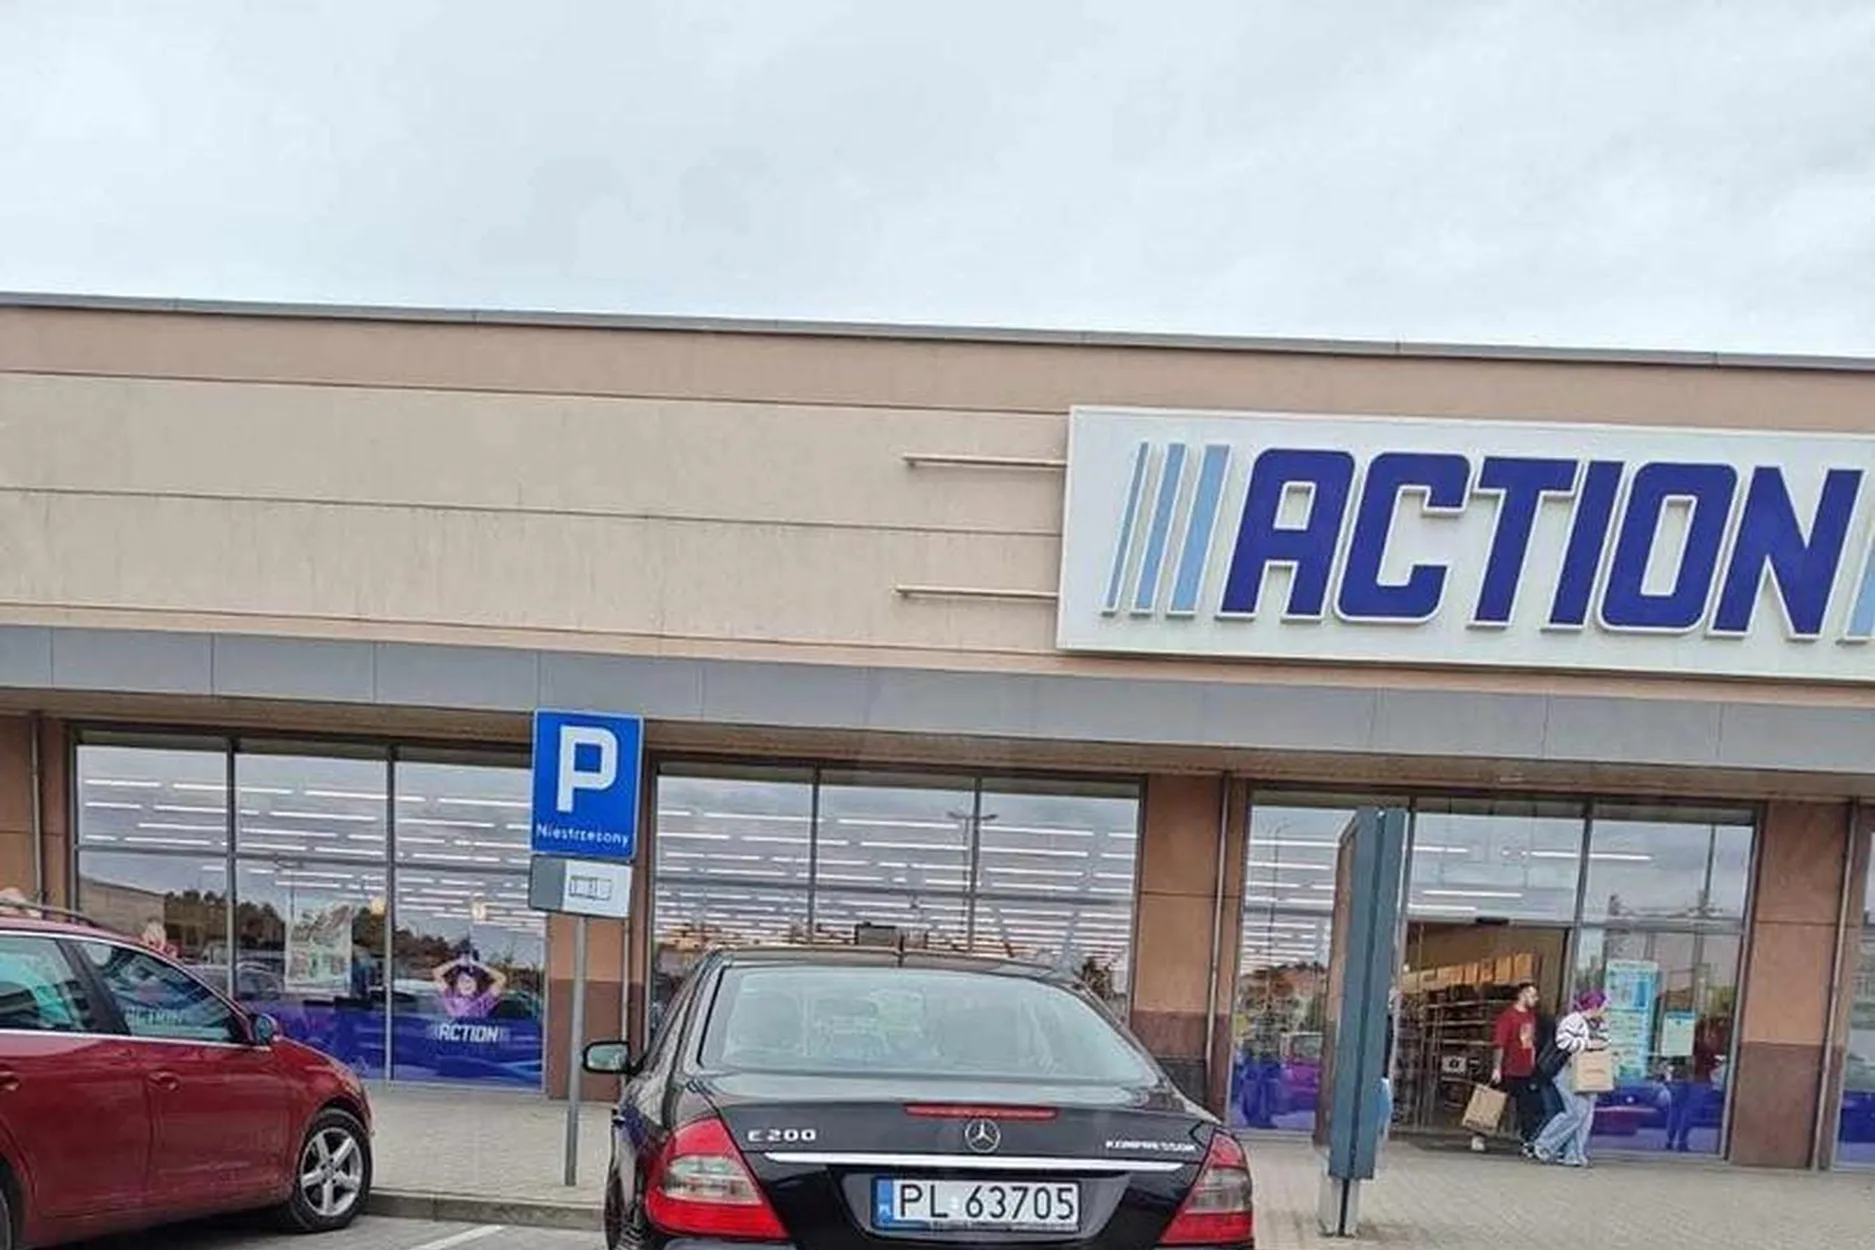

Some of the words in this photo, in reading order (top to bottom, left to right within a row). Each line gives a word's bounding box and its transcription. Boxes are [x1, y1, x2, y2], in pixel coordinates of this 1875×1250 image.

[1216, 447, 1864, 639] ACTION
[556, 725, 618, 813] P
[438, 1023, 499, 1042] ACTION
[766, 1128, 817, 1142] 200
[900, 1184, 948, 1218] PL
[965, 1185, 1074, 1220] 63705
